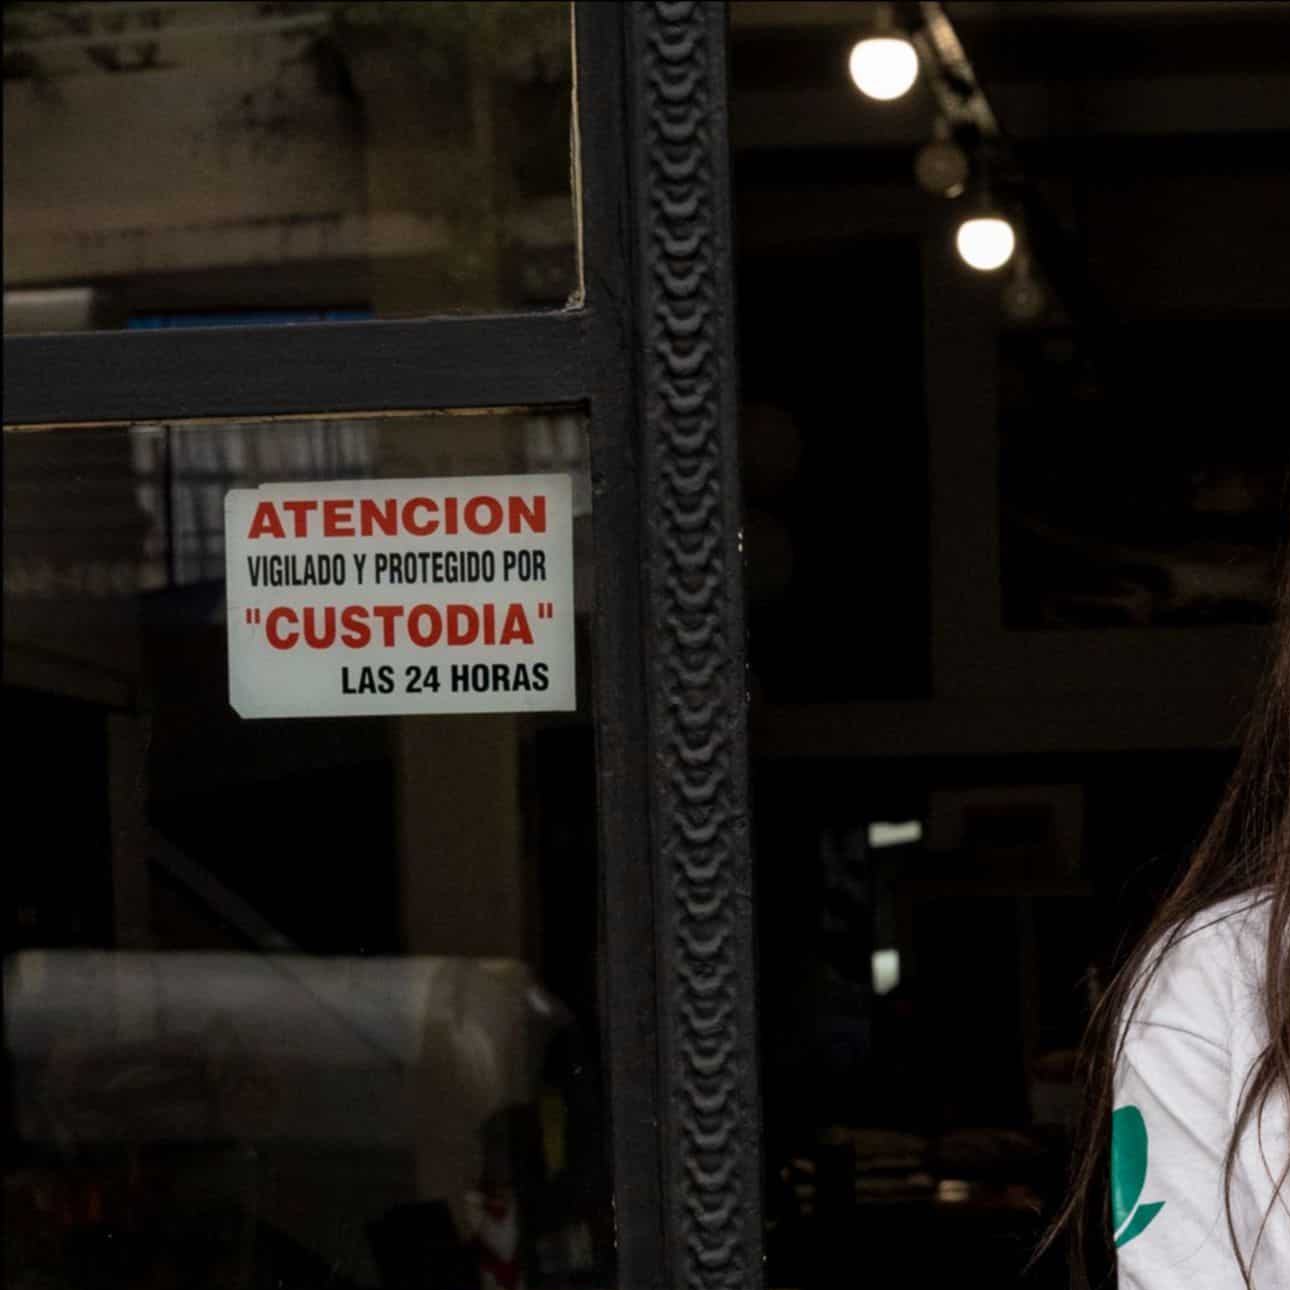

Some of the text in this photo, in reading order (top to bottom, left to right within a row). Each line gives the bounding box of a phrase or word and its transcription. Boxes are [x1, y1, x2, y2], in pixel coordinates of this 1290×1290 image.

[248, 496, 547, 539] ATENCION
[247, 550, 547, 587] VIGILADO Y PROTEGIDO POR
[246, 602, 553, 650] "CUSTODIA"
[341, 662, 549, 695] LAS 24 HORAS
